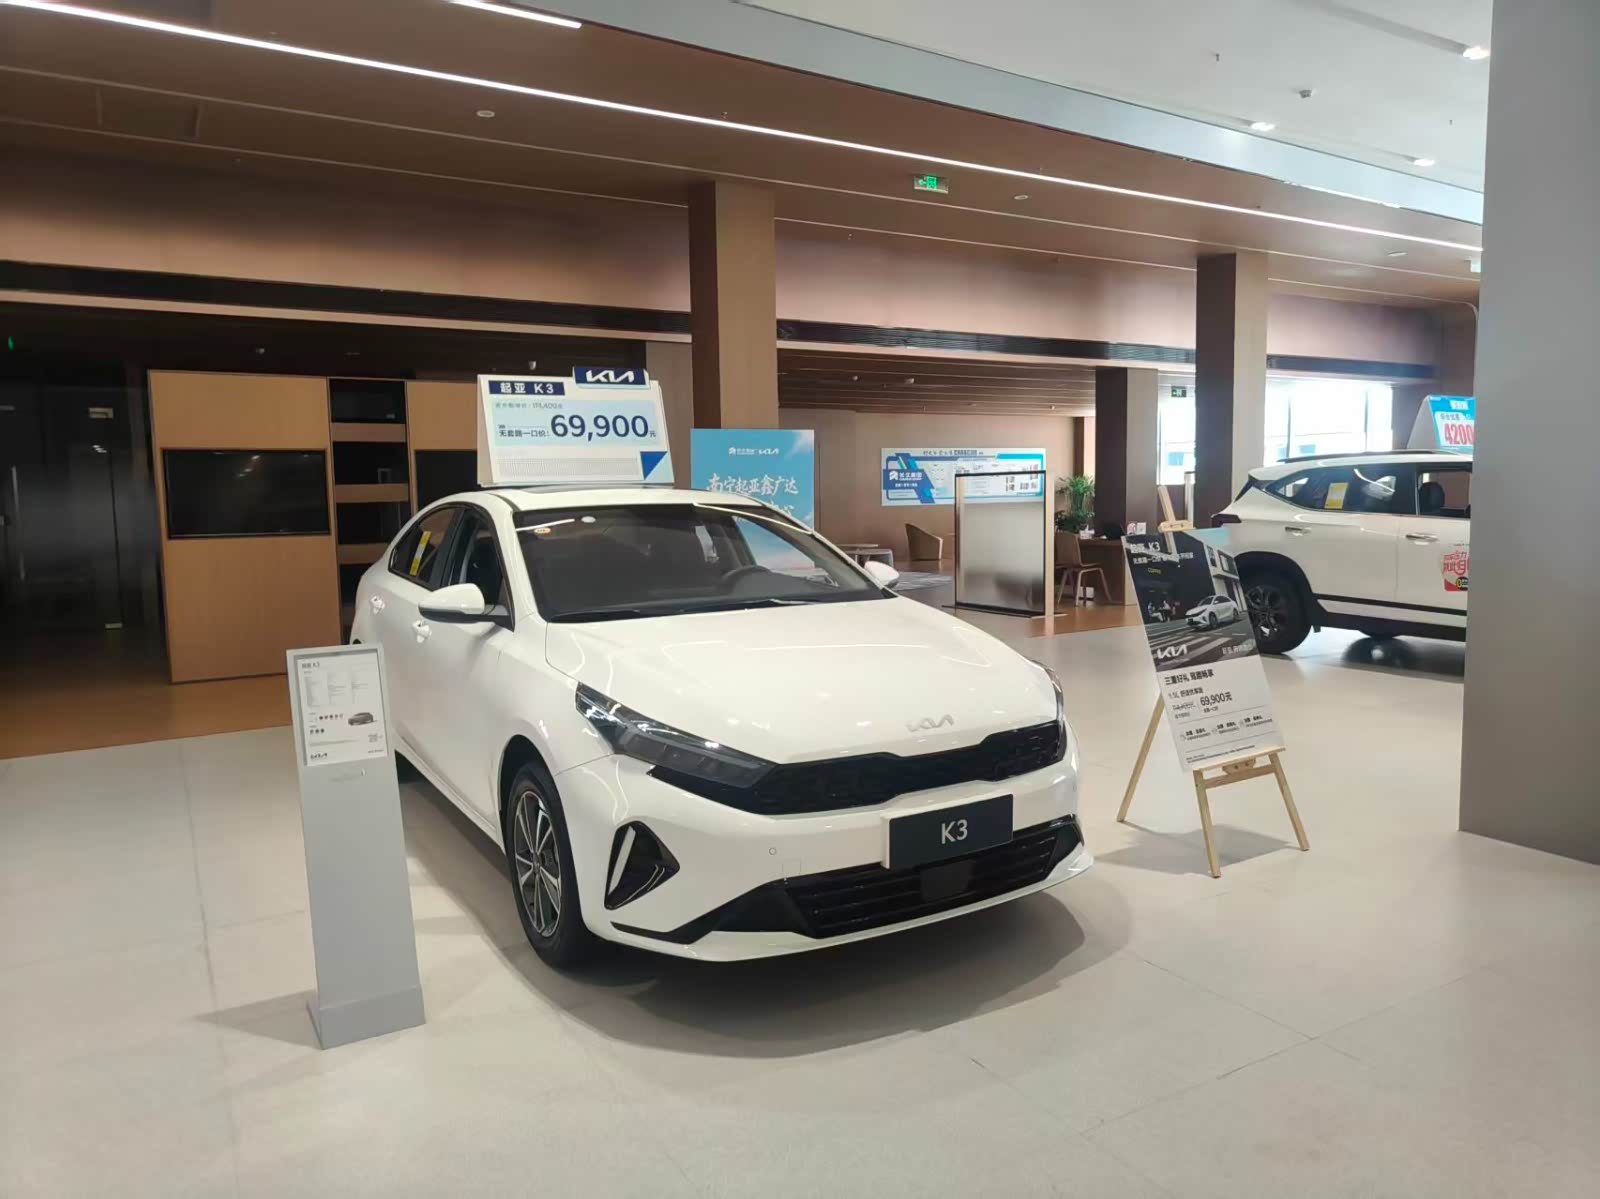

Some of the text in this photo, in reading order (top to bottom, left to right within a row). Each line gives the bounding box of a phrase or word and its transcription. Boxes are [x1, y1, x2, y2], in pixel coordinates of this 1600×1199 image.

[585, 369, 635, 383] KIA
[499, 382, 555, 394] 起亚 K3
[550, 414, 650, 442] 69,900
[707, 473, 799, 496] 南宁起亚鑫广达
[1148, 541, 1160, 552] K3
[1157, 644, 1188, 659] KIA
[941, 819, 968, 845] K3
